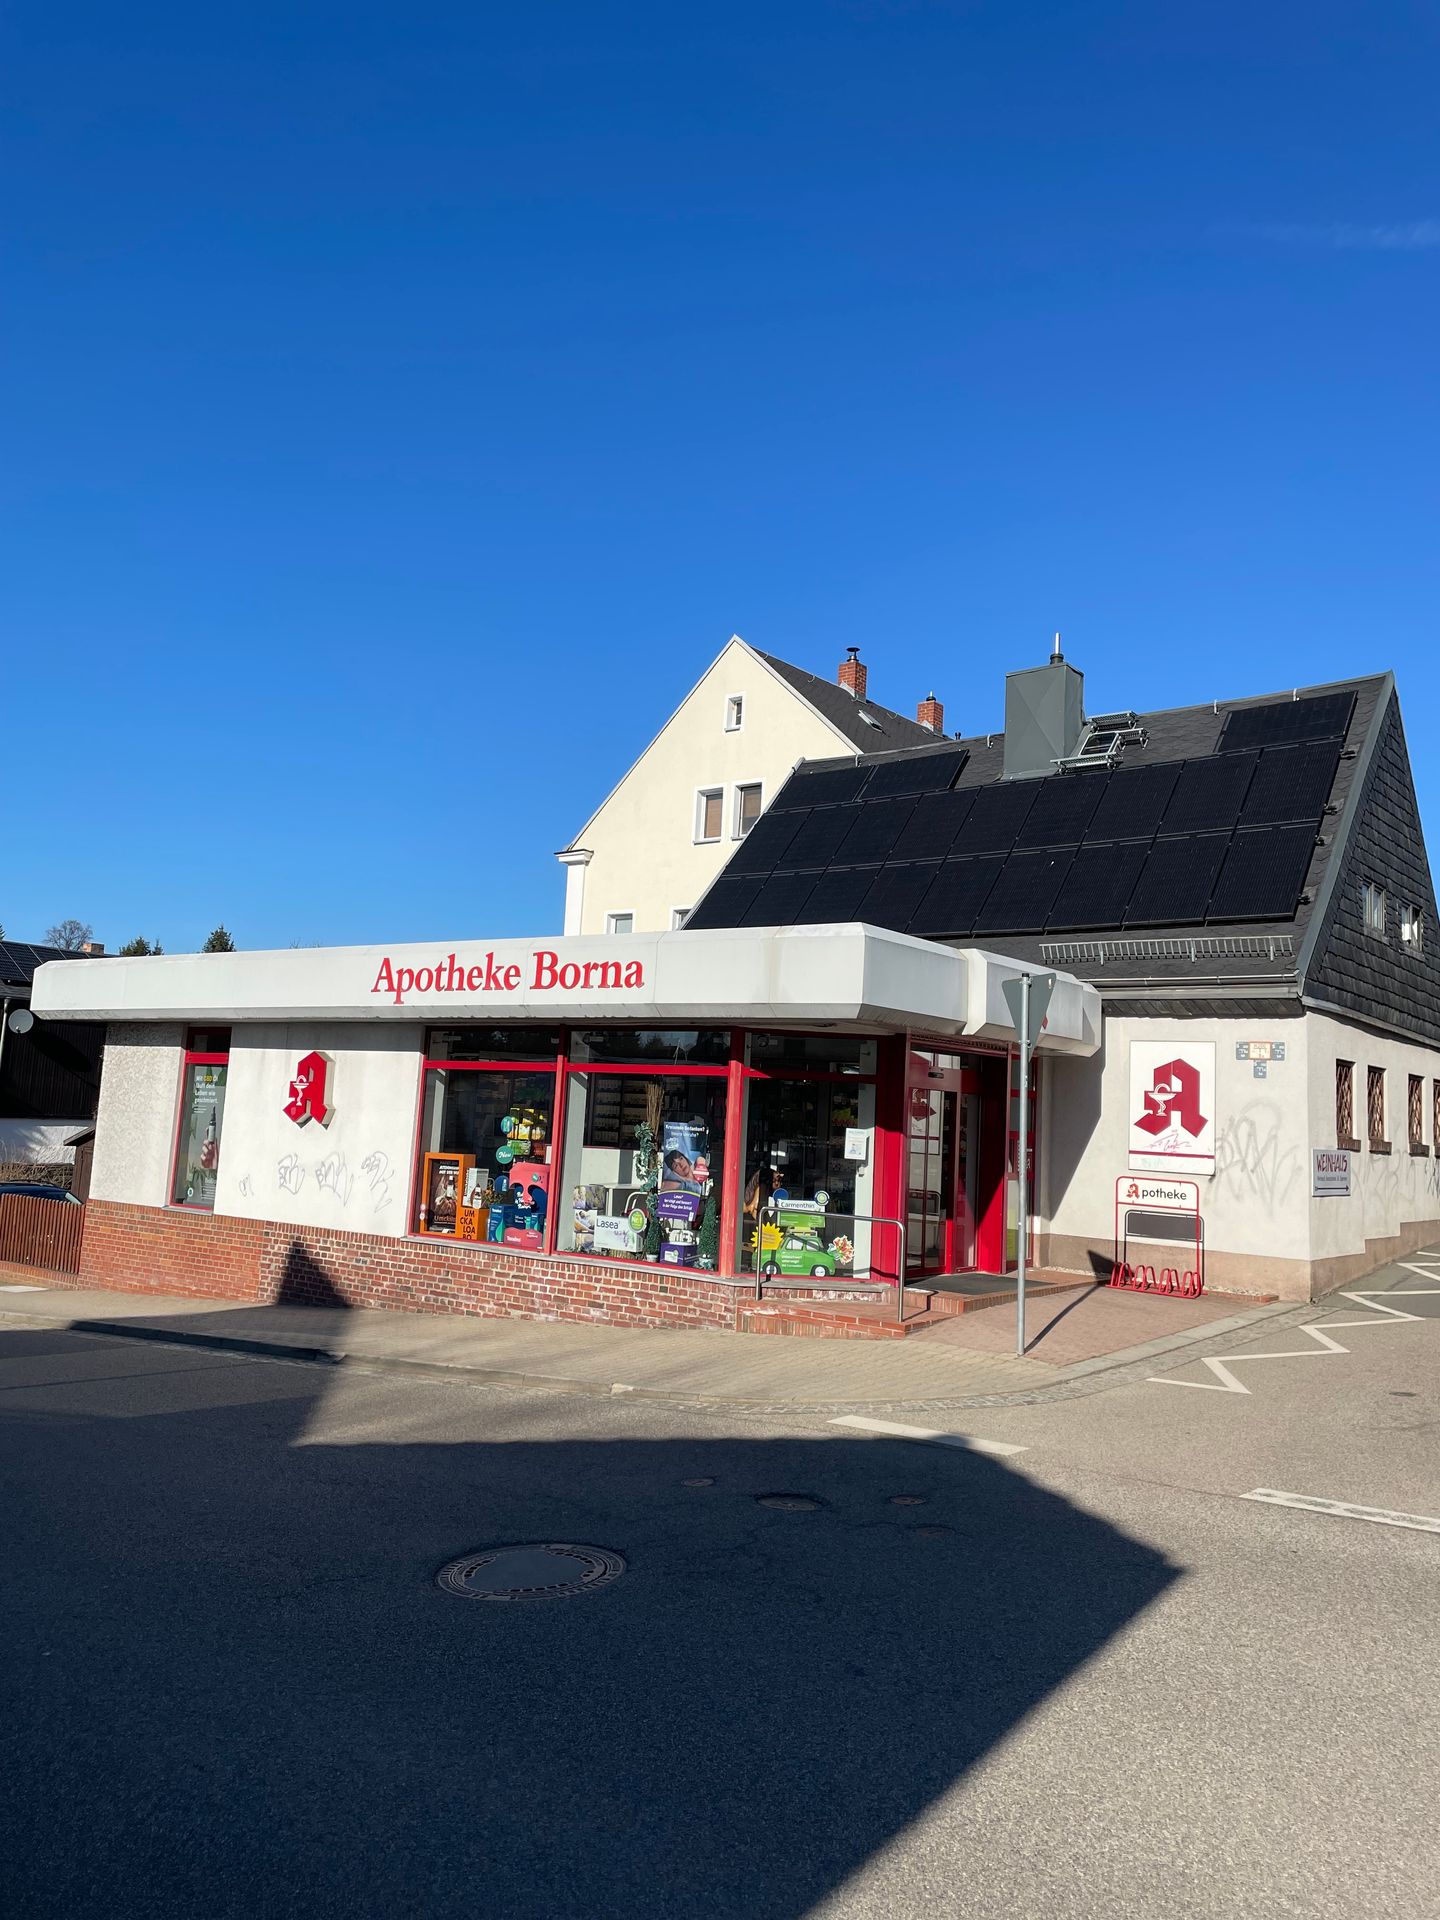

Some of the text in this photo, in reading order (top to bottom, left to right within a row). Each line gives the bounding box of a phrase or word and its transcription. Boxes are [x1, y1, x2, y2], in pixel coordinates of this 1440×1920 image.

[371, 951, 644, 1004] Apotheke Borna
[498, 1151, 511, 1159] New
[1316, 1153, 1347, 1172] WEINHAUS
[464, 1209, 475, 1218] UM
[460, 1217, 473, 1225] CKA
[596, 1218, 619, 1230] Lasea
[463, 1225, 475, 1234] LOA
